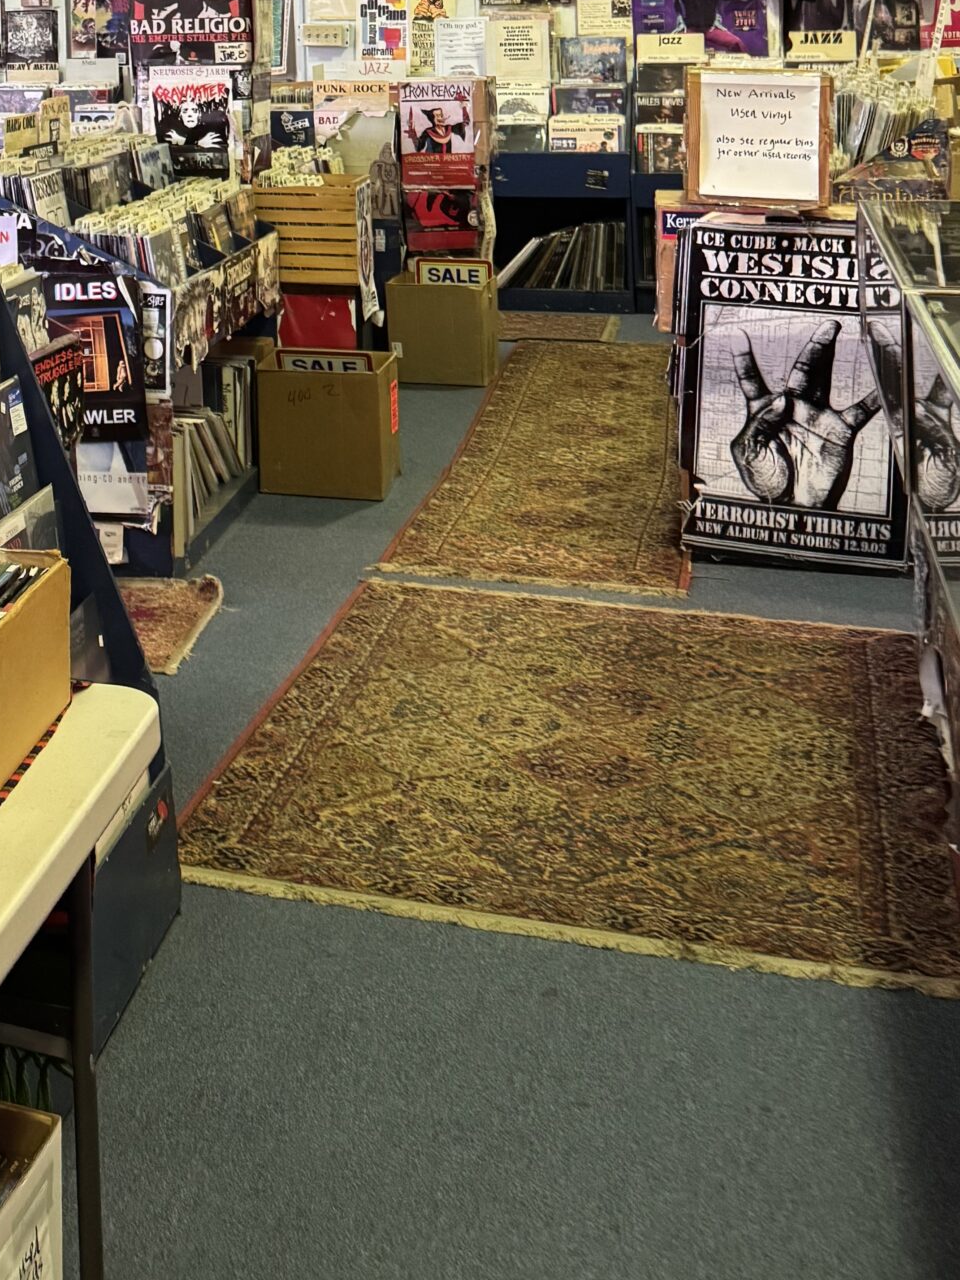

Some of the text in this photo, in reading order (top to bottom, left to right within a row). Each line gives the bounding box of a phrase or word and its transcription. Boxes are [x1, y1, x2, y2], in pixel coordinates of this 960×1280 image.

[130, 16, 251, 35] BAD RELIGION
[149, 35, 184, 43] EMPIRE
[186, 34, 228, 42] STRIKES
[658, 35, 683, 47] jazz
[800, 32, 843, 45] JAZZ
[8, 63, 59, 71] HEAVY METAL
[153, 68, 194, 77] NEUROSIS
[358, 61, 391, 76] JAZZ
[316, 83, 386, 94] PUNK ROCK
[401, 82, 471, 100] IRON REAGAN
[716, 88, 796, 99] New Arrivals
[638, 98, 660, 106] MILES
[318, 116, 339, 125] BAD
[716, 136, 814, 151] also see regular bins
[733, 148, 759, 159] other
[783, 151, 812, 162] records
[696, 231, 846, 254] ICE CUBE MACK
[427, 266, 481, 285] SALE
[54, 280, 118, 302] IDLES
[695, 500, 892, 541] TERRORIST THREATS
[696, 521, 723, 536] NEW
[726, 524, 770, 542] ALBUM
[772, 530, 787, 544] IN
[789, 532, 841, 551] STORES
